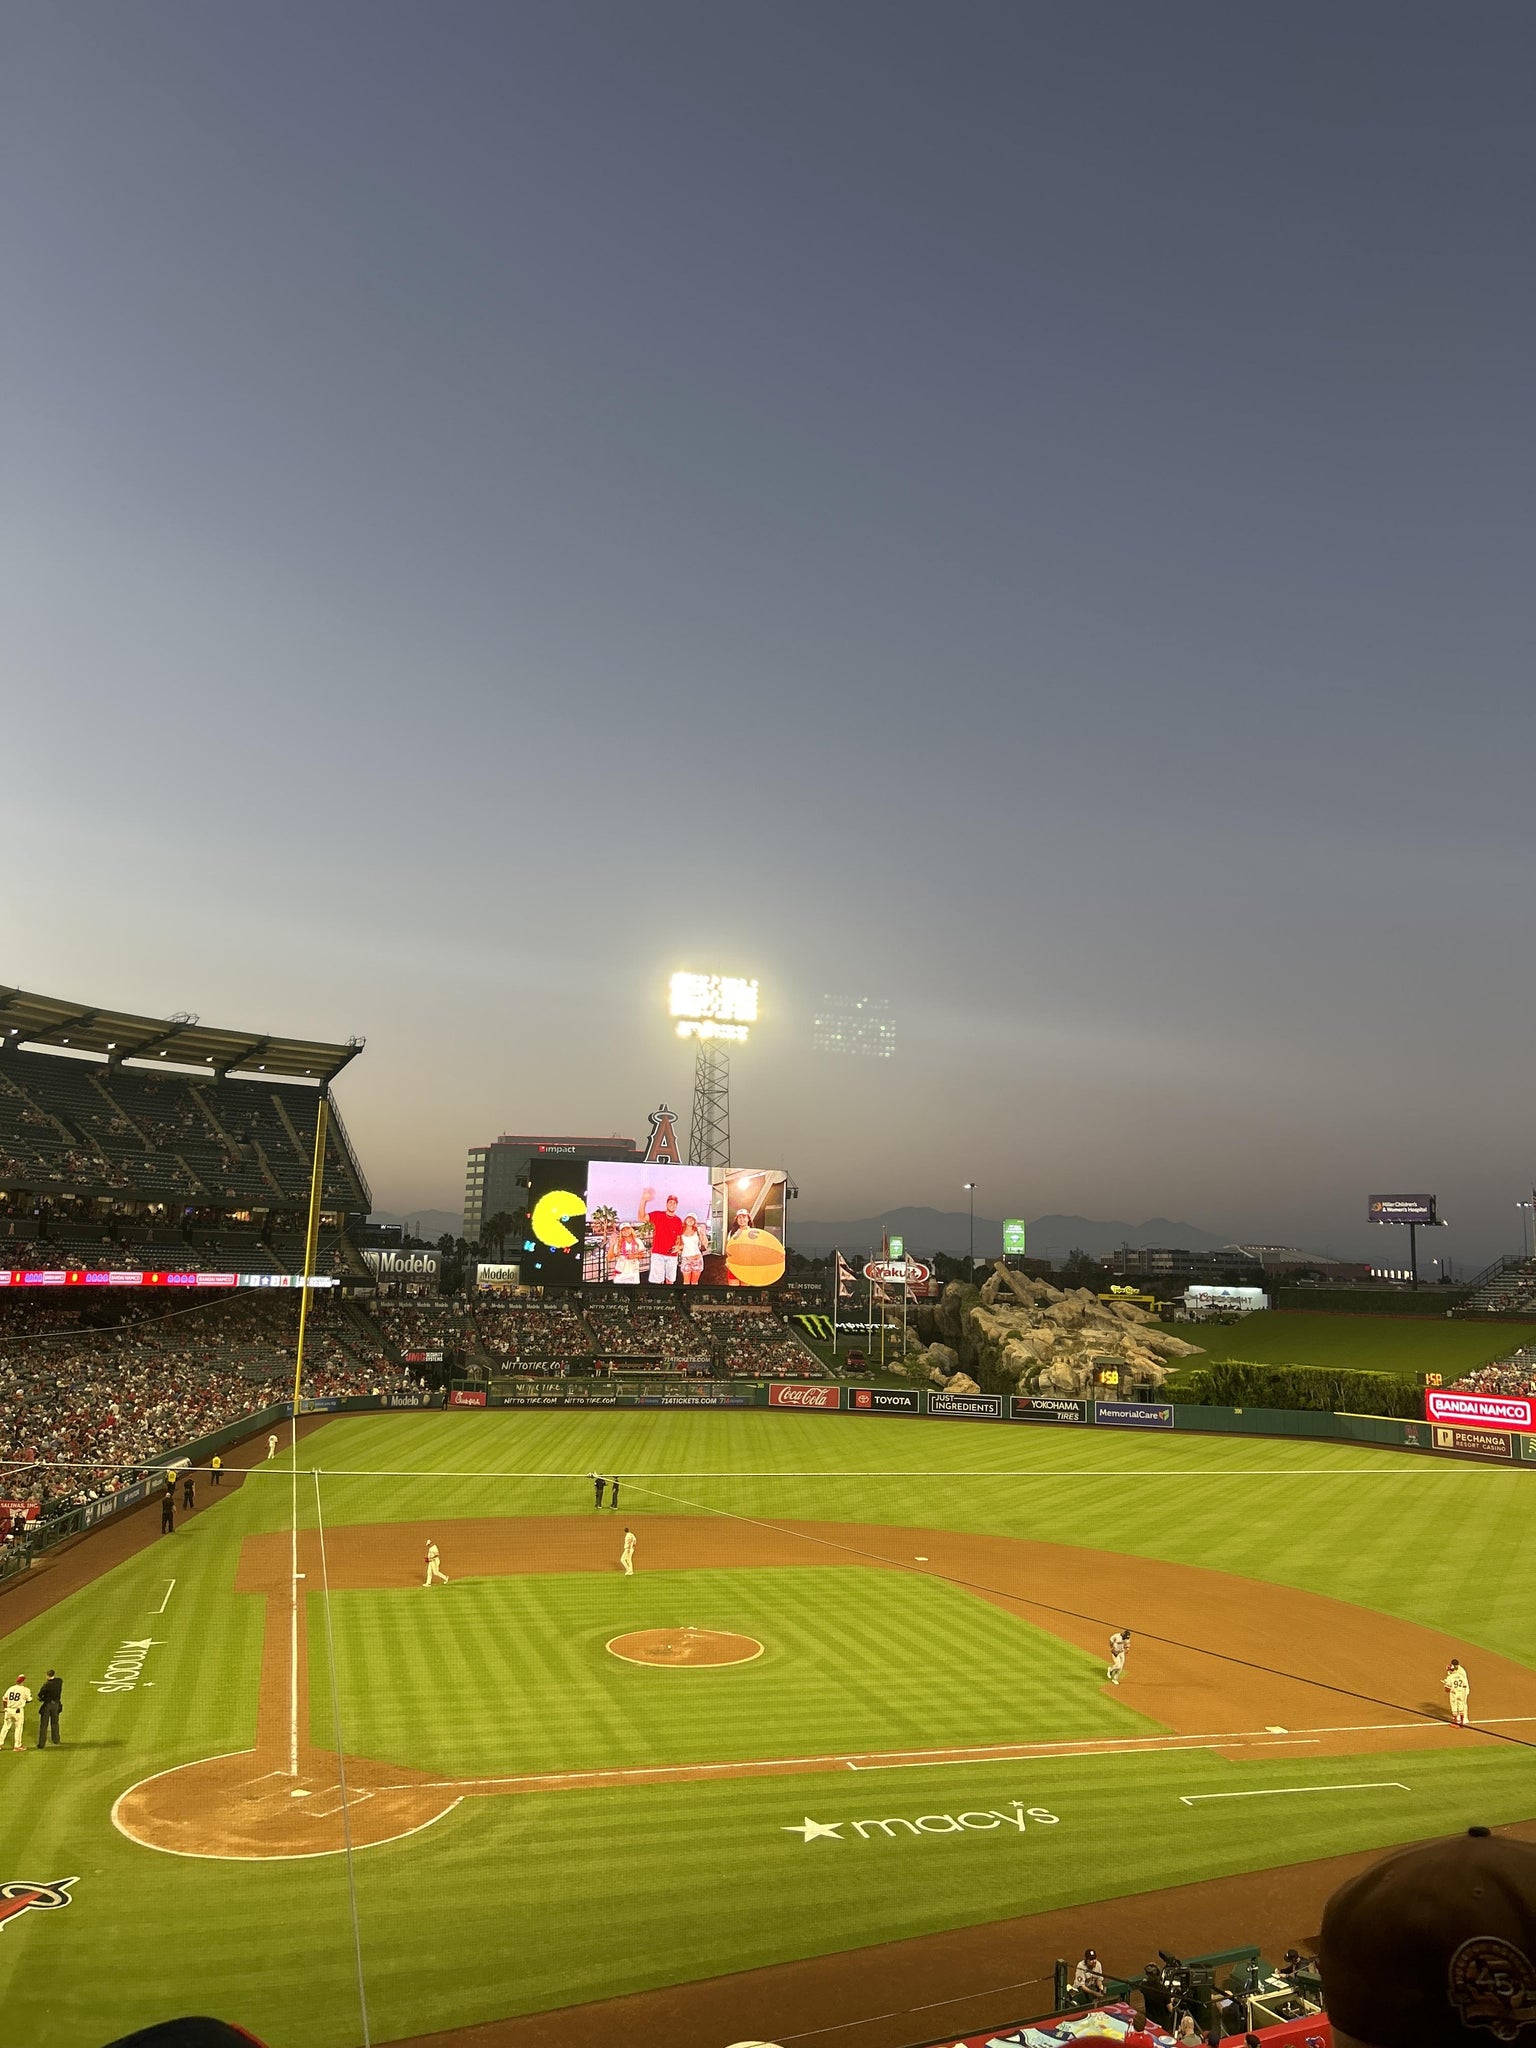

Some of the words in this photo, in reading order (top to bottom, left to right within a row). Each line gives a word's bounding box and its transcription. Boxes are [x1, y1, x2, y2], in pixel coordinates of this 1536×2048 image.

[545, 1145, 576, 1154] impact
[380, 1252, 437, 1273] Modelo
[482, 1267, 515, 1280] Modelo
[875, 1266, 917, 1278] Yakut
[391, 1395, 419, 1406] Modelo
[661, 1397, 717, 1405] 714TICKETS.COM
[778, 1387, 829, 1406] Coca-Cola
[874, 1395, 912, 1406] TOYOTA
[935, 1394, 955, 1402] JUST
[935, 1402, 994, 1412] INGREDIENTS
[1032, 1400, 1079, 1411] YOKOHAMA
[1435, 1400, 1478, 1414] BANDAI
[1480, 1404, 1525, 1418] NAMCO
[1057, 1412, 1080, 1421] TIRES
[1099, 1408, 1159, 1420] MemorialCare
[1455, 1432, 1506, 1446] PECHANGA
[1456, 1441, 1479, 1449] RESORT
[1483, 1444, 1506, 1452] CASINO
[9, 1692, 21, 1701] 88
